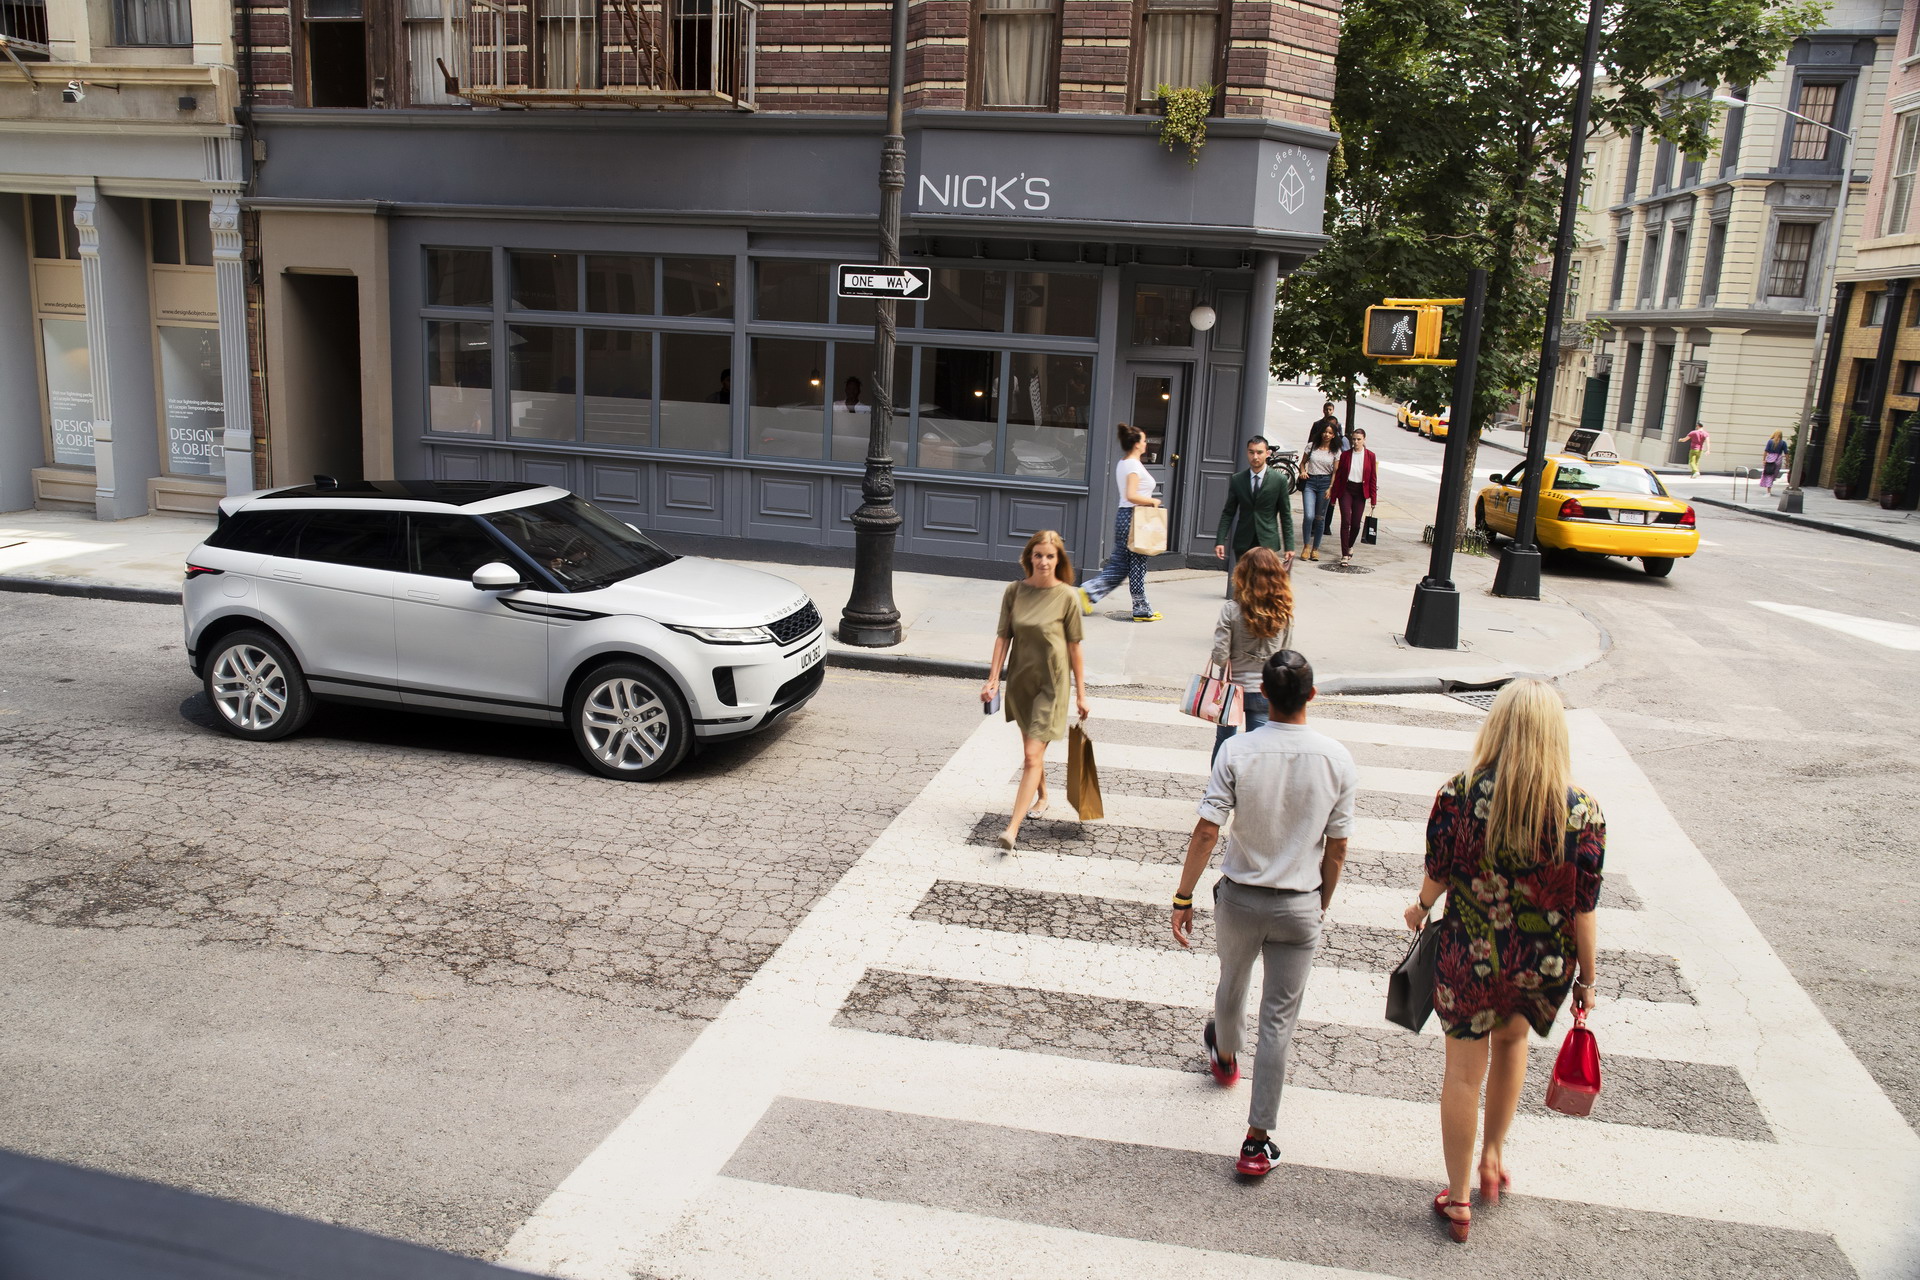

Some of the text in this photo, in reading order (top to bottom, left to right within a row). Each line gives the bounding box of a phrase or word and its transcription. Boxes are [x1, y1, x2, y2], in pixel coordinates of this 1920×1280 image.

[1270, 146, 1316, 181] coffee house
[918, 172, 1050, 210] NICK'S
[852, 276, 912, 288] ONE WAY
[54, 419, 93, 433] DESIGN
[56, 433, 64, 445] &
[170, 428, 214, 442] DESIGN
[171, 442, 225, 457] & OBJECT
[764, 594, 808, 620] RANGE ROVER
[801, 651, 812, 668] UCN
